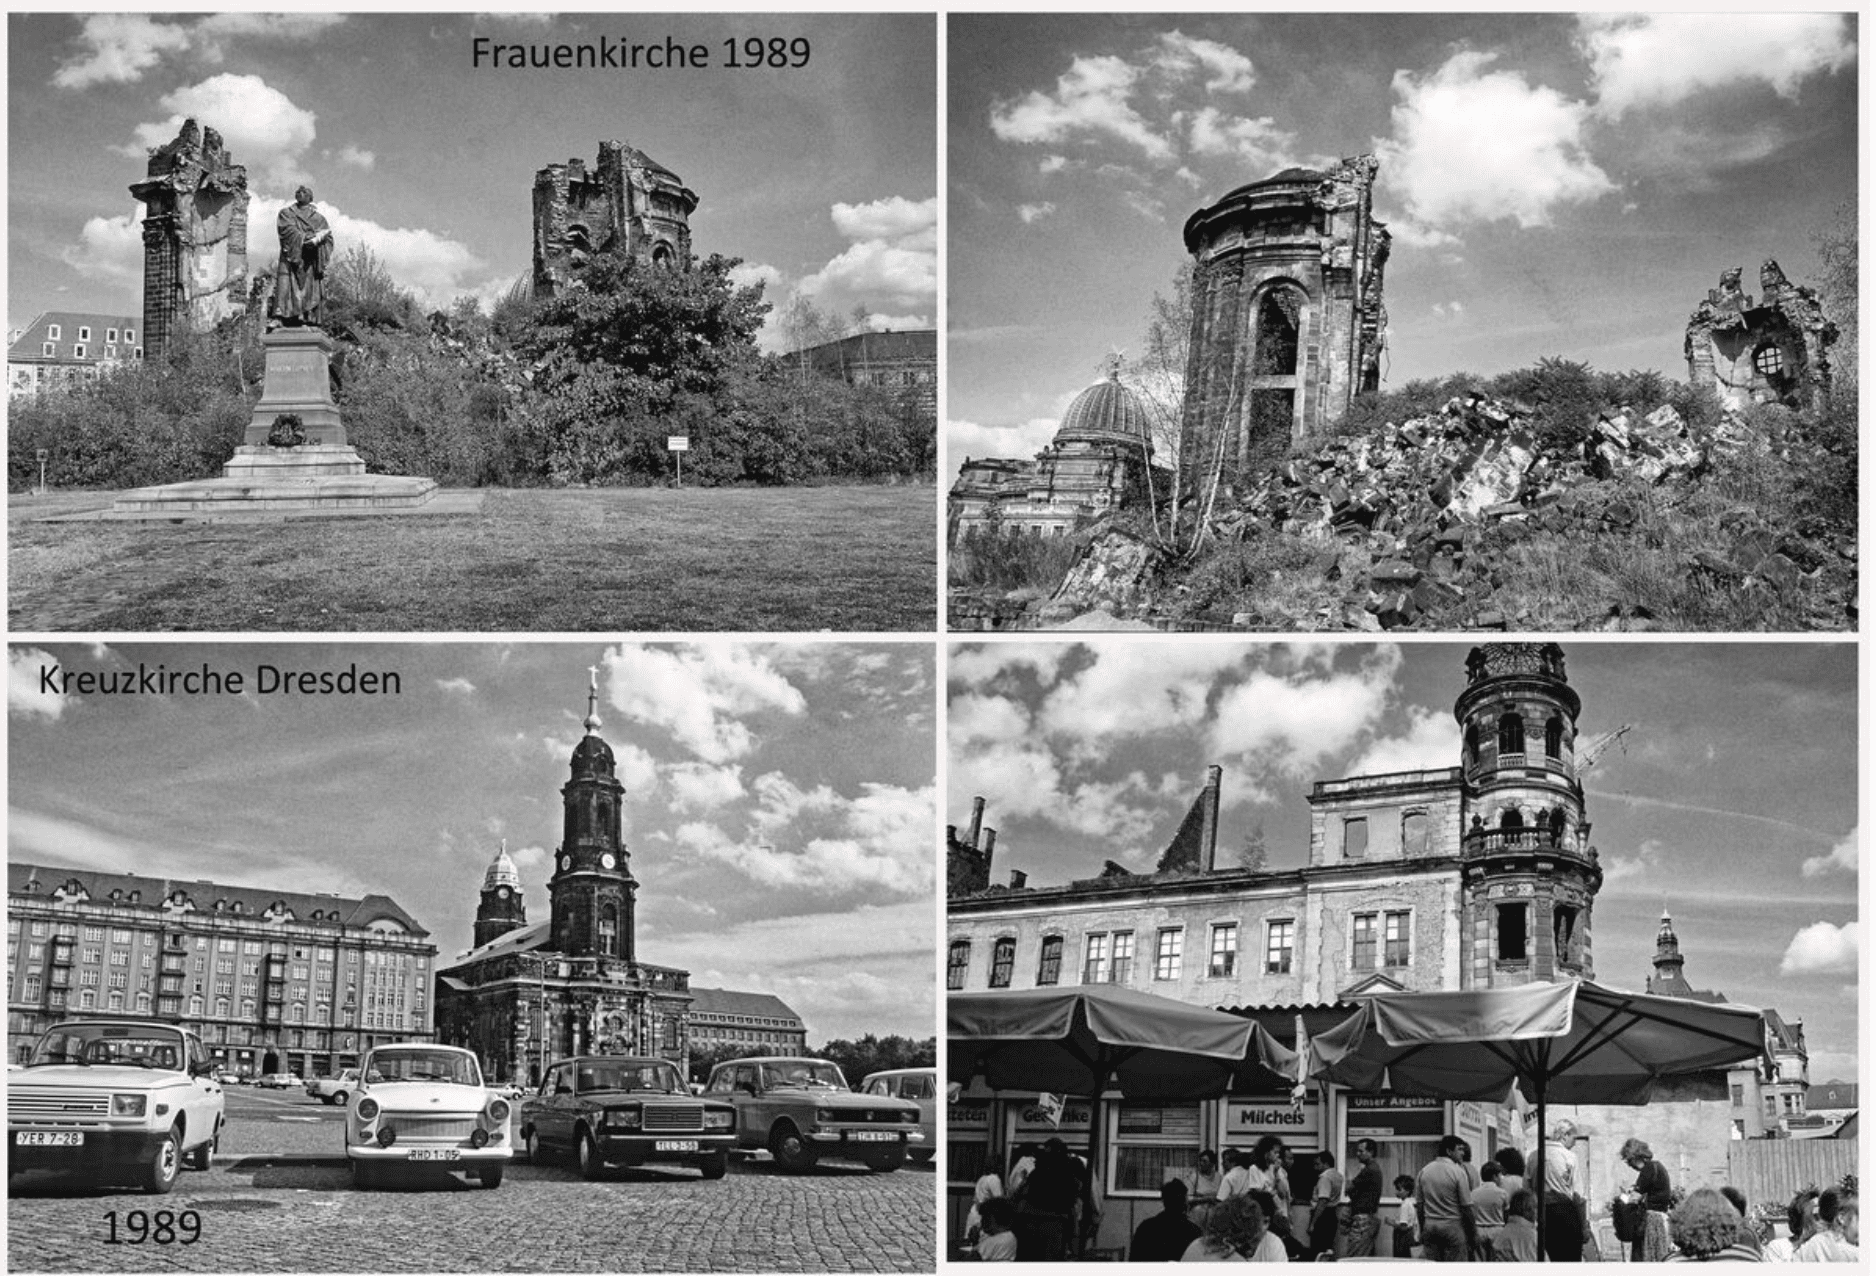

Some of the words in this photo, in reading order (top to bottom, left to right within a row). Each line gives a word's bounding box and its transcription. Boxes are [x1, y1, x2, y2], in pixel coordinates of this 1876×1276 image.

[1354, 1096, 1386, 1107] Unser
[1240, 1109, 1305, 1126] Milcheis
[21, 1132, 45, 1145] YER
[50, 1132, 79, 1145] 7-28
